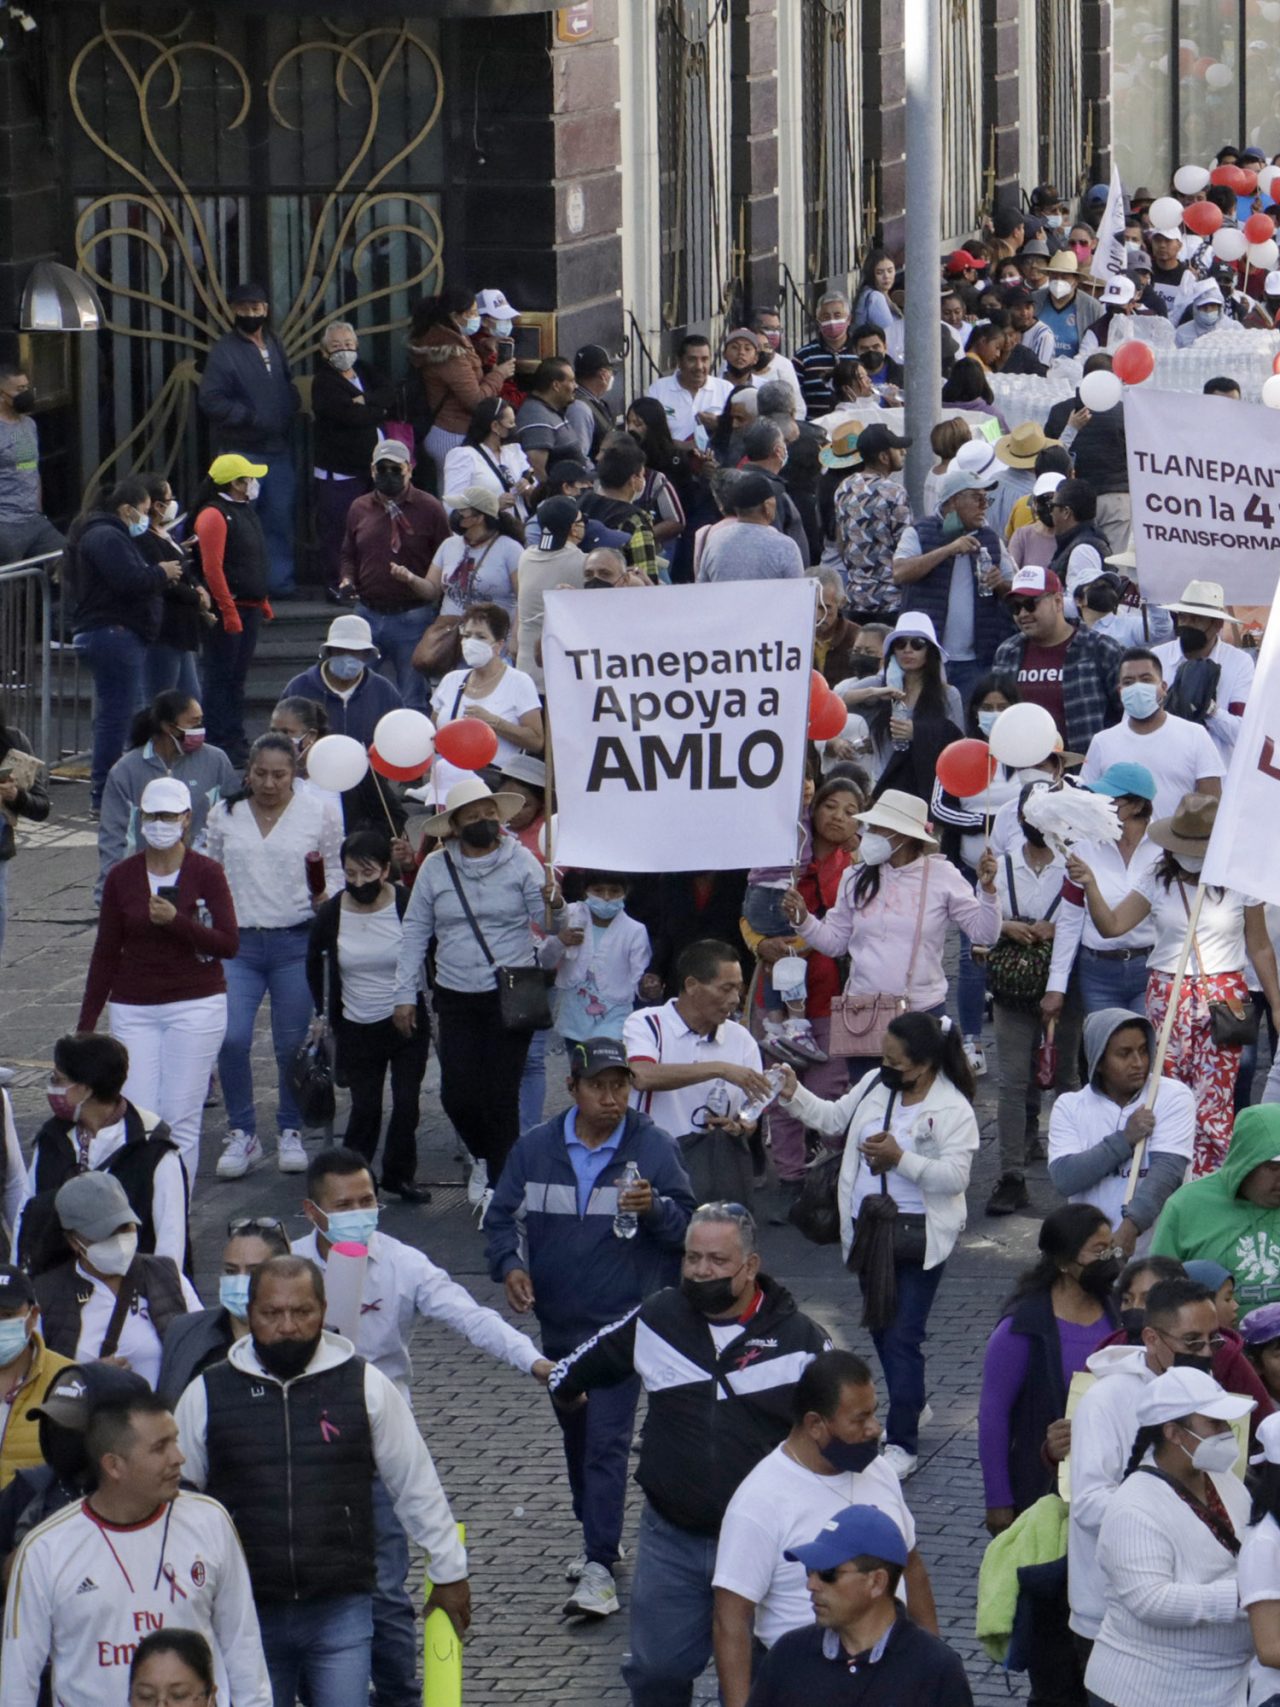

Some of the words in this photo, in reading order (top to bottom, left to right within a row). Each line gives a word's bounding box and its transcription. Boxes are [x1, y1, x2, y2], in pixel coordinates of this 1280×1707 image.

[1146, 493, 1202, 518] con
[1208, 495, 1235, 522] la
[565, 641, 801, 684] Tlanepantla
[592, 685, 746, 732] Apoya
[757, 687, 780, 717] a
[585, 729, 784, 792] AMLO
[133, 1611, 164, 1632] Fly
